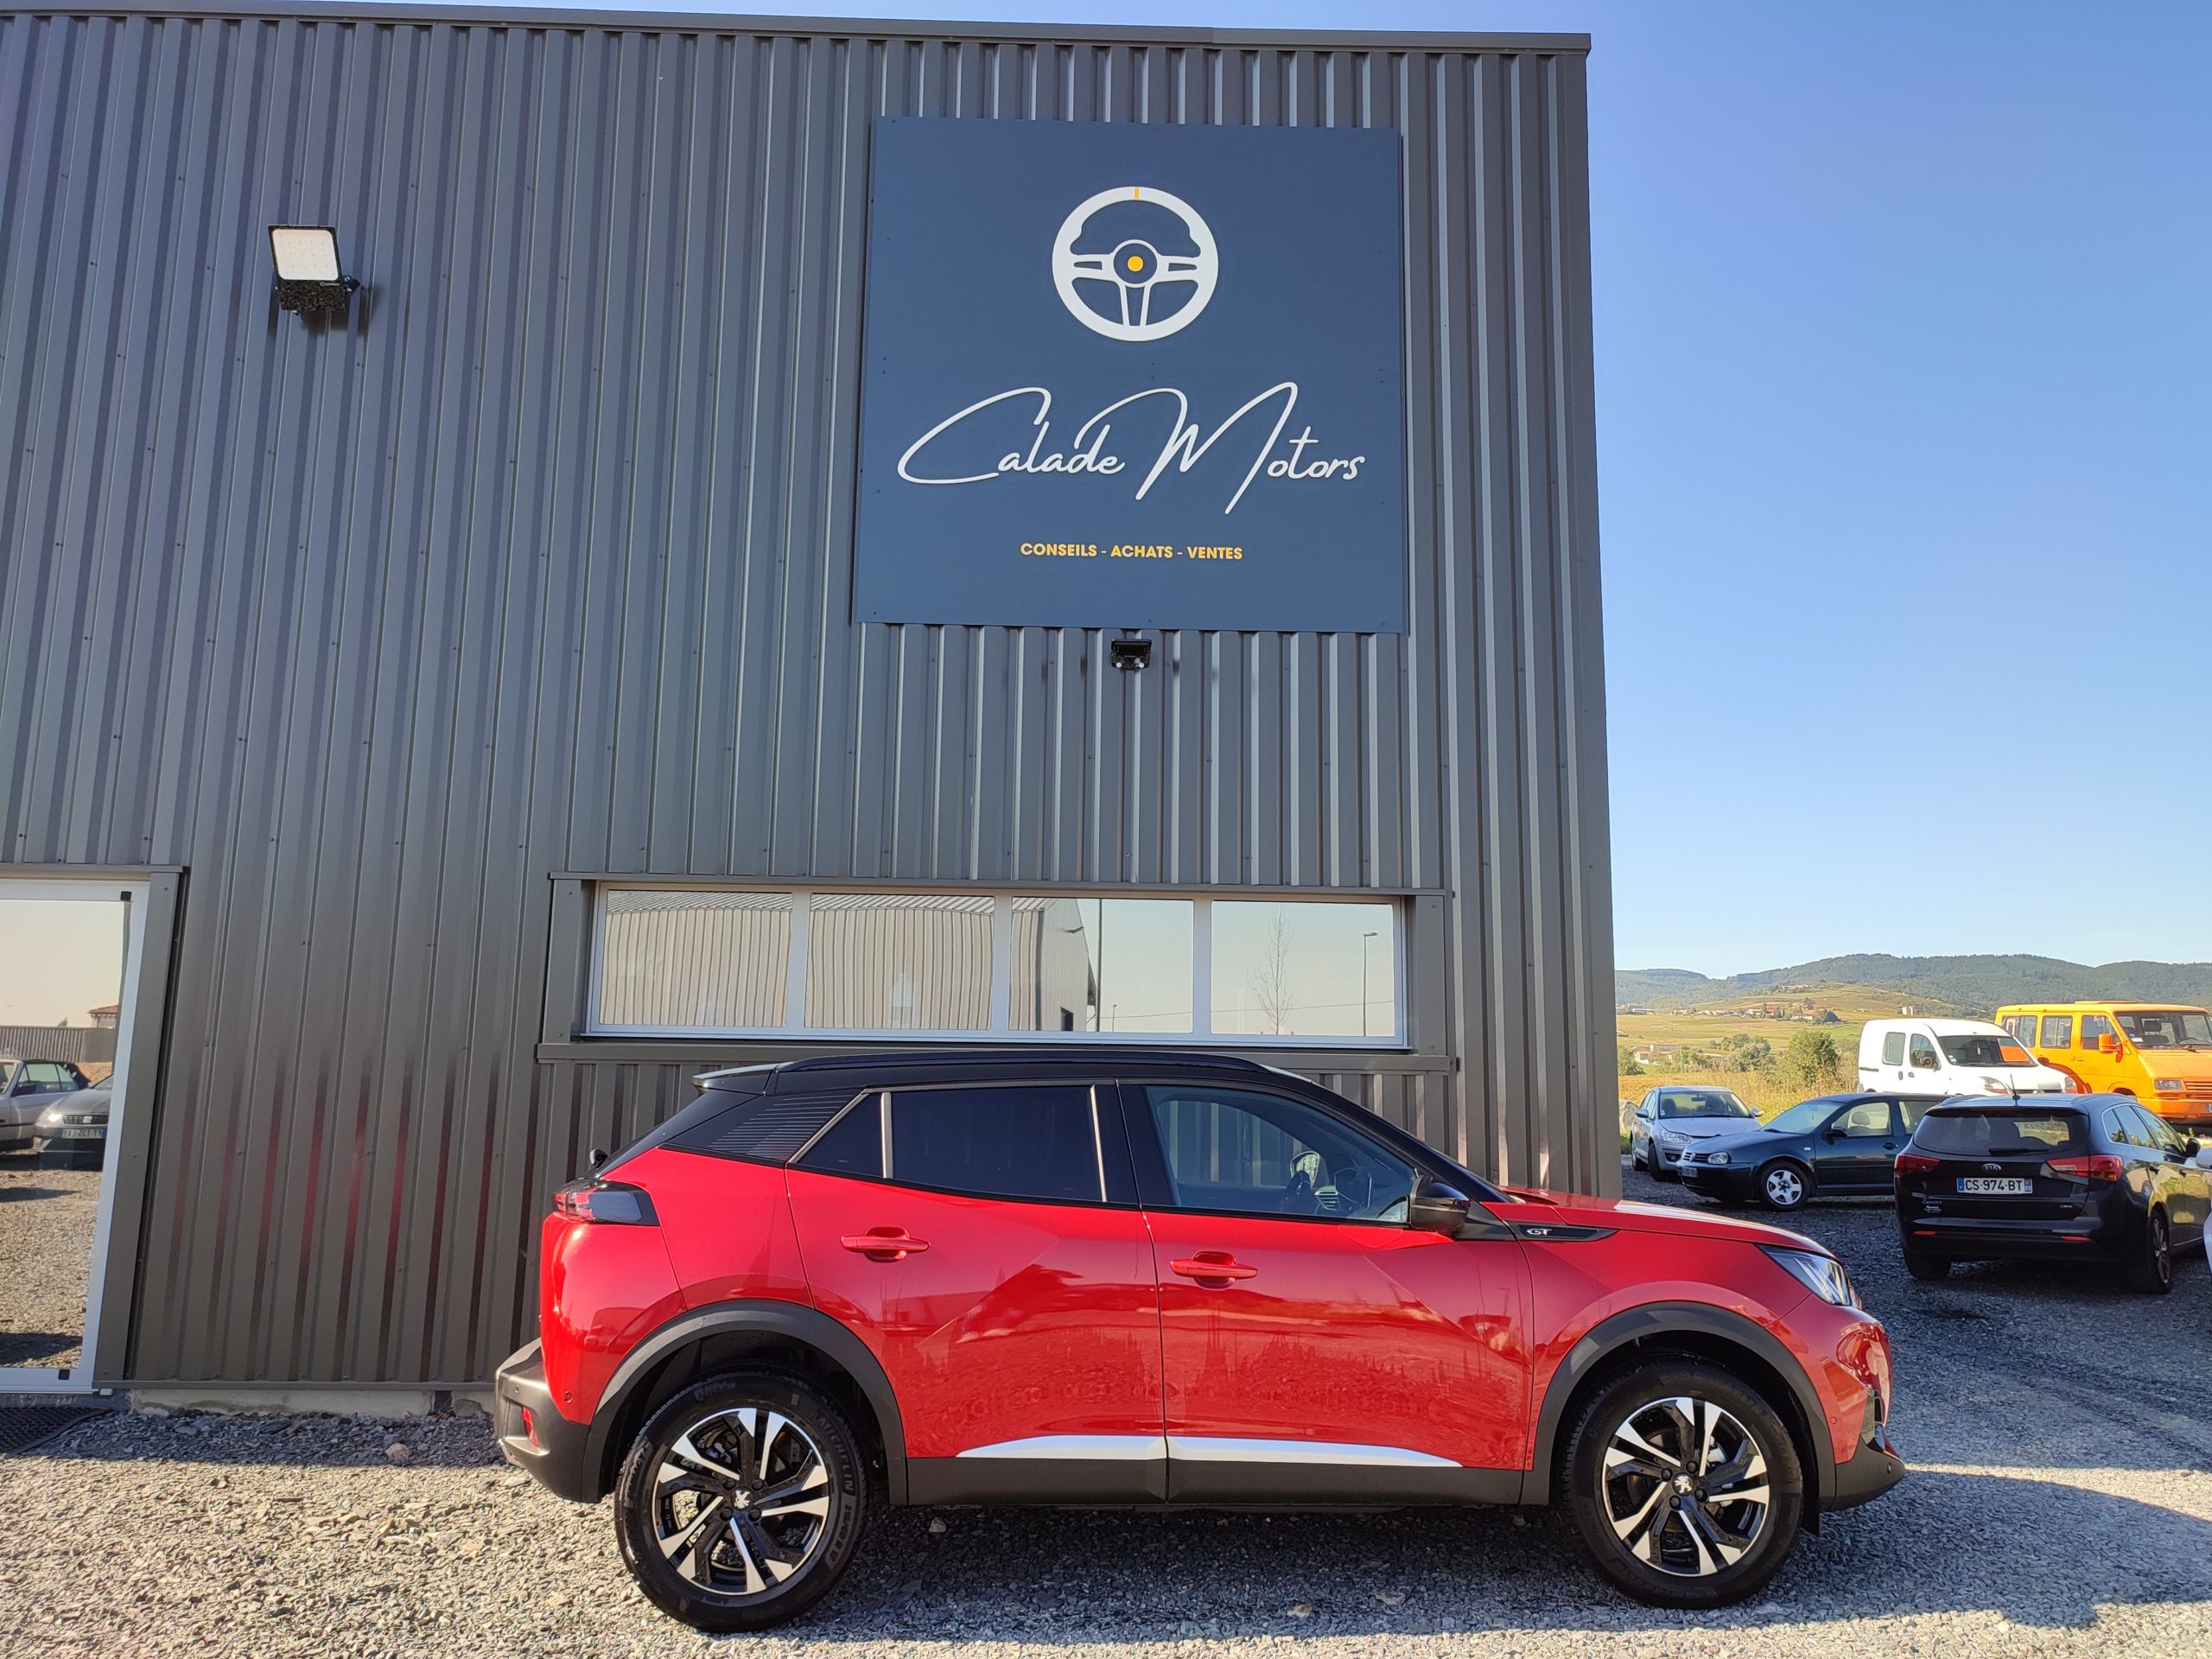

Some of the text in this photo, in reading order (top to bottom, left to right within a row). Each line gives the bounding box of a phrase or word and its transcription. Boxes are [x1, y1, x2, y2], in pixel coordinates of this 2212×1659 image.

[897, 381, 1366, 515] Calade Motors
[1020, 543, 1097, 557] CONSEILS
[1110, 544, 1173, 559] ACHATS
[1186, 546, 1243, 560] VENTES
